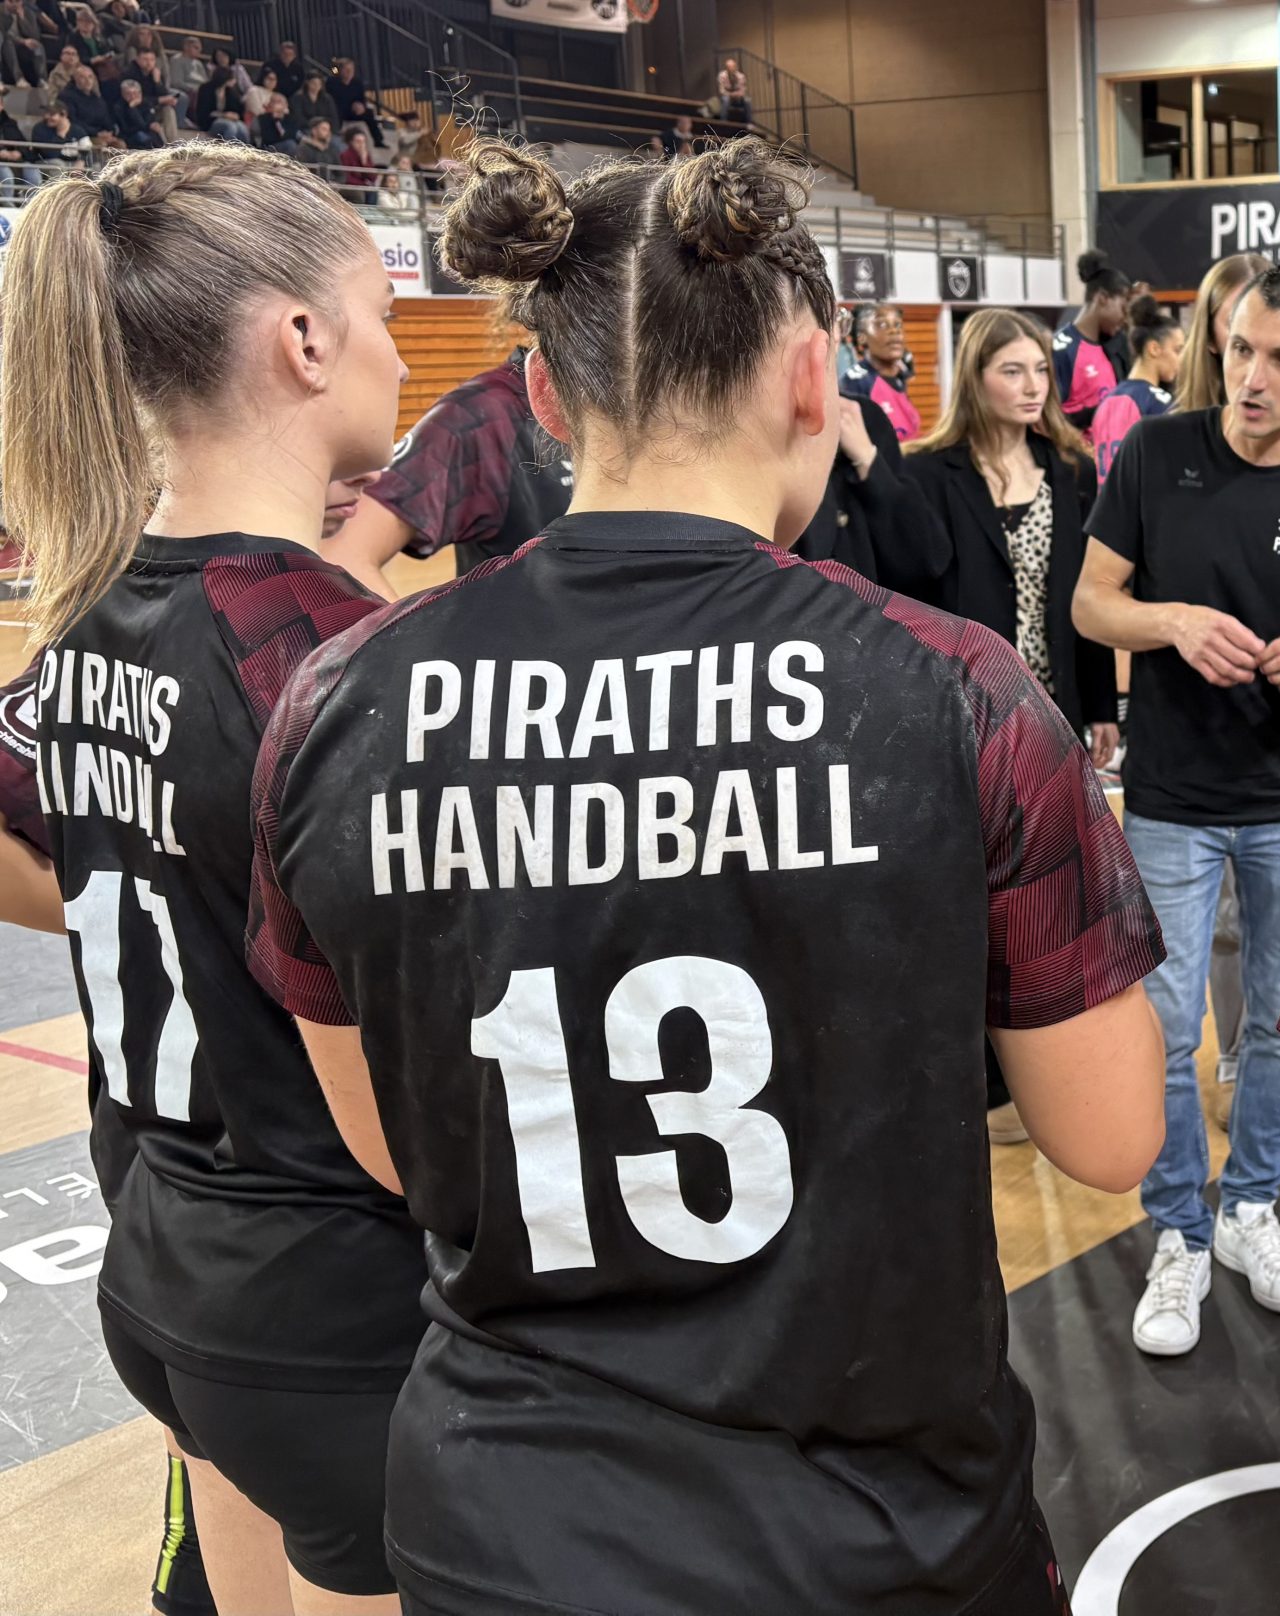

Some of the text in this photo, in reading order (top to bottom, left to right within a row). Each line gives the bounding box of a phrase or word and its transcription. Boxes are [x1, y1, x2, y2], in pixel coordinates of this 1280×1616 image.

[380, 242, 419, 267] sio
[406, 640, 825, 763] PIRATHS
[371, 764, 880, 896] HANDBALL
[471, 954, 795, 1274] 13
